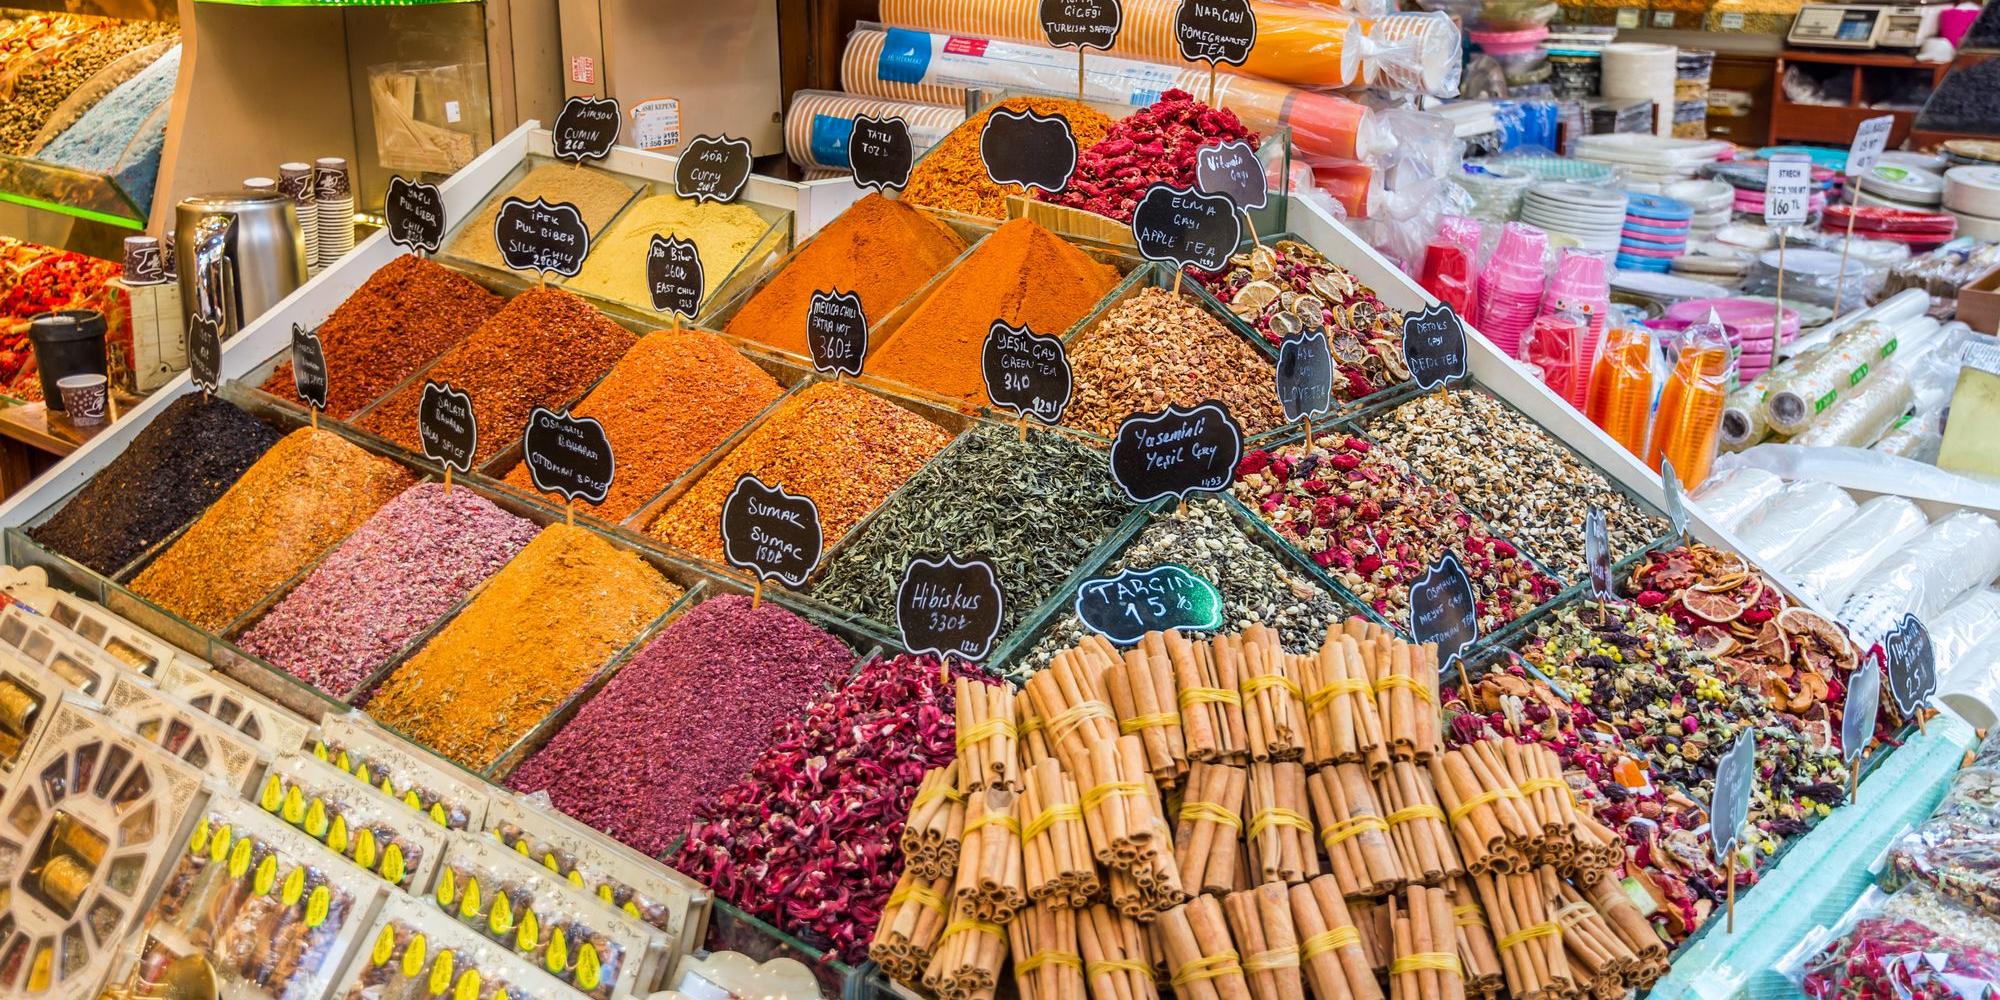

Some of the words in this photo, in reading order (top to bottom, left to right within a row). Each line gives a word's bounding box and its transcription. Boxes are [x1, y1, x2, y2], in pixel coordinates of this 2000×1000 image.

[1195, 3, 1220, 21] NAR
[1046, 22, 1086, 33] TURKISH
[1196, 42, 1225, 56] TEA
[564, 127, 600, 142] CUMIN
[867, 129, 892, 144] TATLI
[515, 220, 536, 234] PUL
[1141, 227, 1175, 248] APPLE
[1185, 241, 1216, 257] TEA
[656, 281, 676, 295] EAST
[812, 316, 834, 333] EXTRA
[836, 323, 852, 336] HOT
[1001, 354, 1034, 369] GREEN
[1037, 362, 1057, 377] TEA
[1004, 372, 1030, 391] 340
[748, 497, 806, 529] SUMAK
[751, 526, 803, 560] SUMAC
[911, 582, 981, 610] Hibiskus
